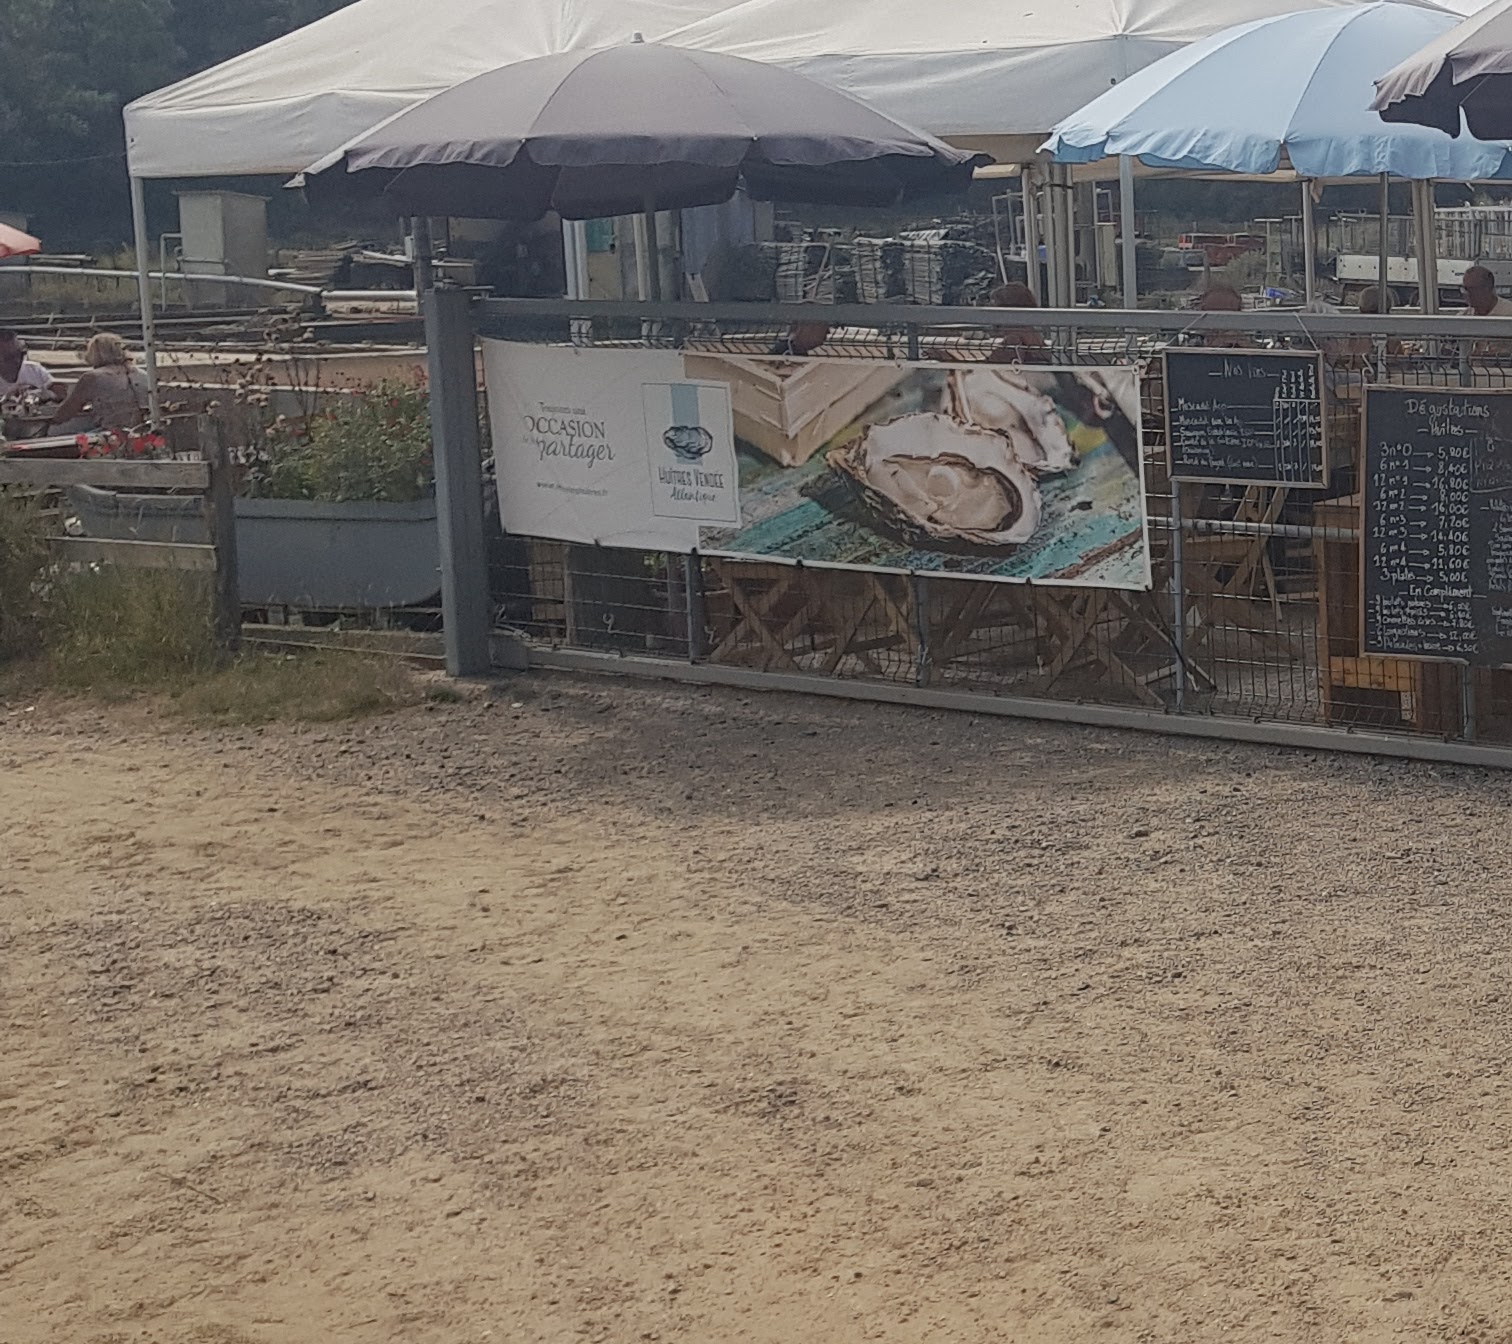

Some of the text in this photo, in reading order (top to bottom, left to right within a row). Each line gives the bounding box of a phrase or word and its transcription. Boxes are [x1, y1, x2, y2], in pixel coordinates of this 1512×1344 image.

[1404, 397, 1490, 426] Dégustations
[523, 414, 606, 441] OCCASION
[533, 436, 616, 469] partager
[1380, 457, 1388, 471] 6
[1372, 473, 1387, 487] 12
[1380, 488, 1388, 500] 6
[1380, 513, 1387, 526] 6
[1372, 526, 1387, 538] 12
[1379, 542, 1387, 554] 6
[1373, 556, 1387, 567] 12
[1409, 584, 1422, 596] En
